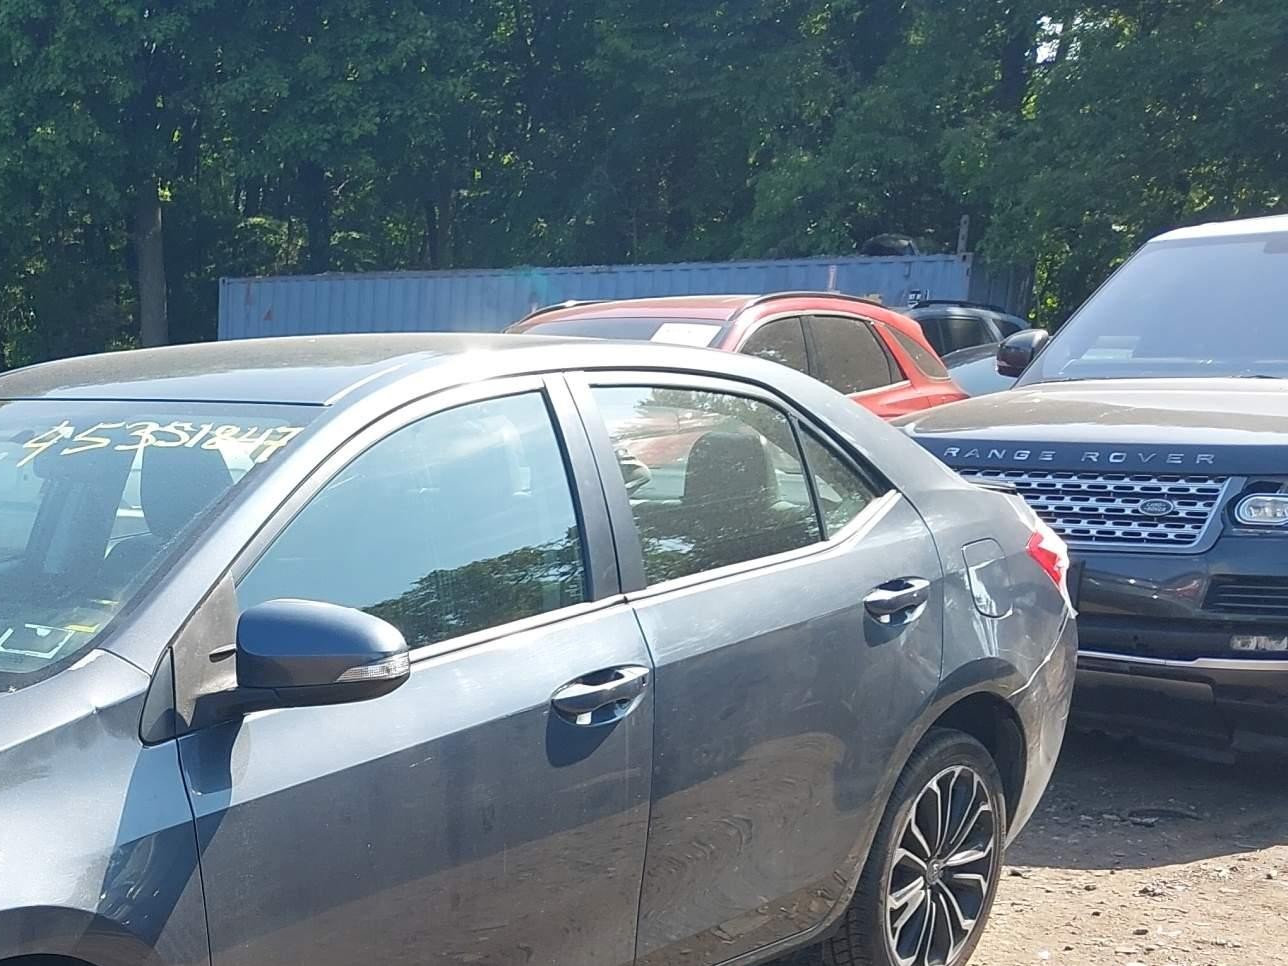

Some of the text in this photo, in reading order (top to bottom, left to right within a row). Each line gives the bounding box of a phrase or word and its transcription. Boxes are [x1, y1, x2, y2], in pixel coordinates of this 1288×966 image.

[16, 420, 305, 468] 45351847
[943, 447, 1215, 465] RANGE ROVER
